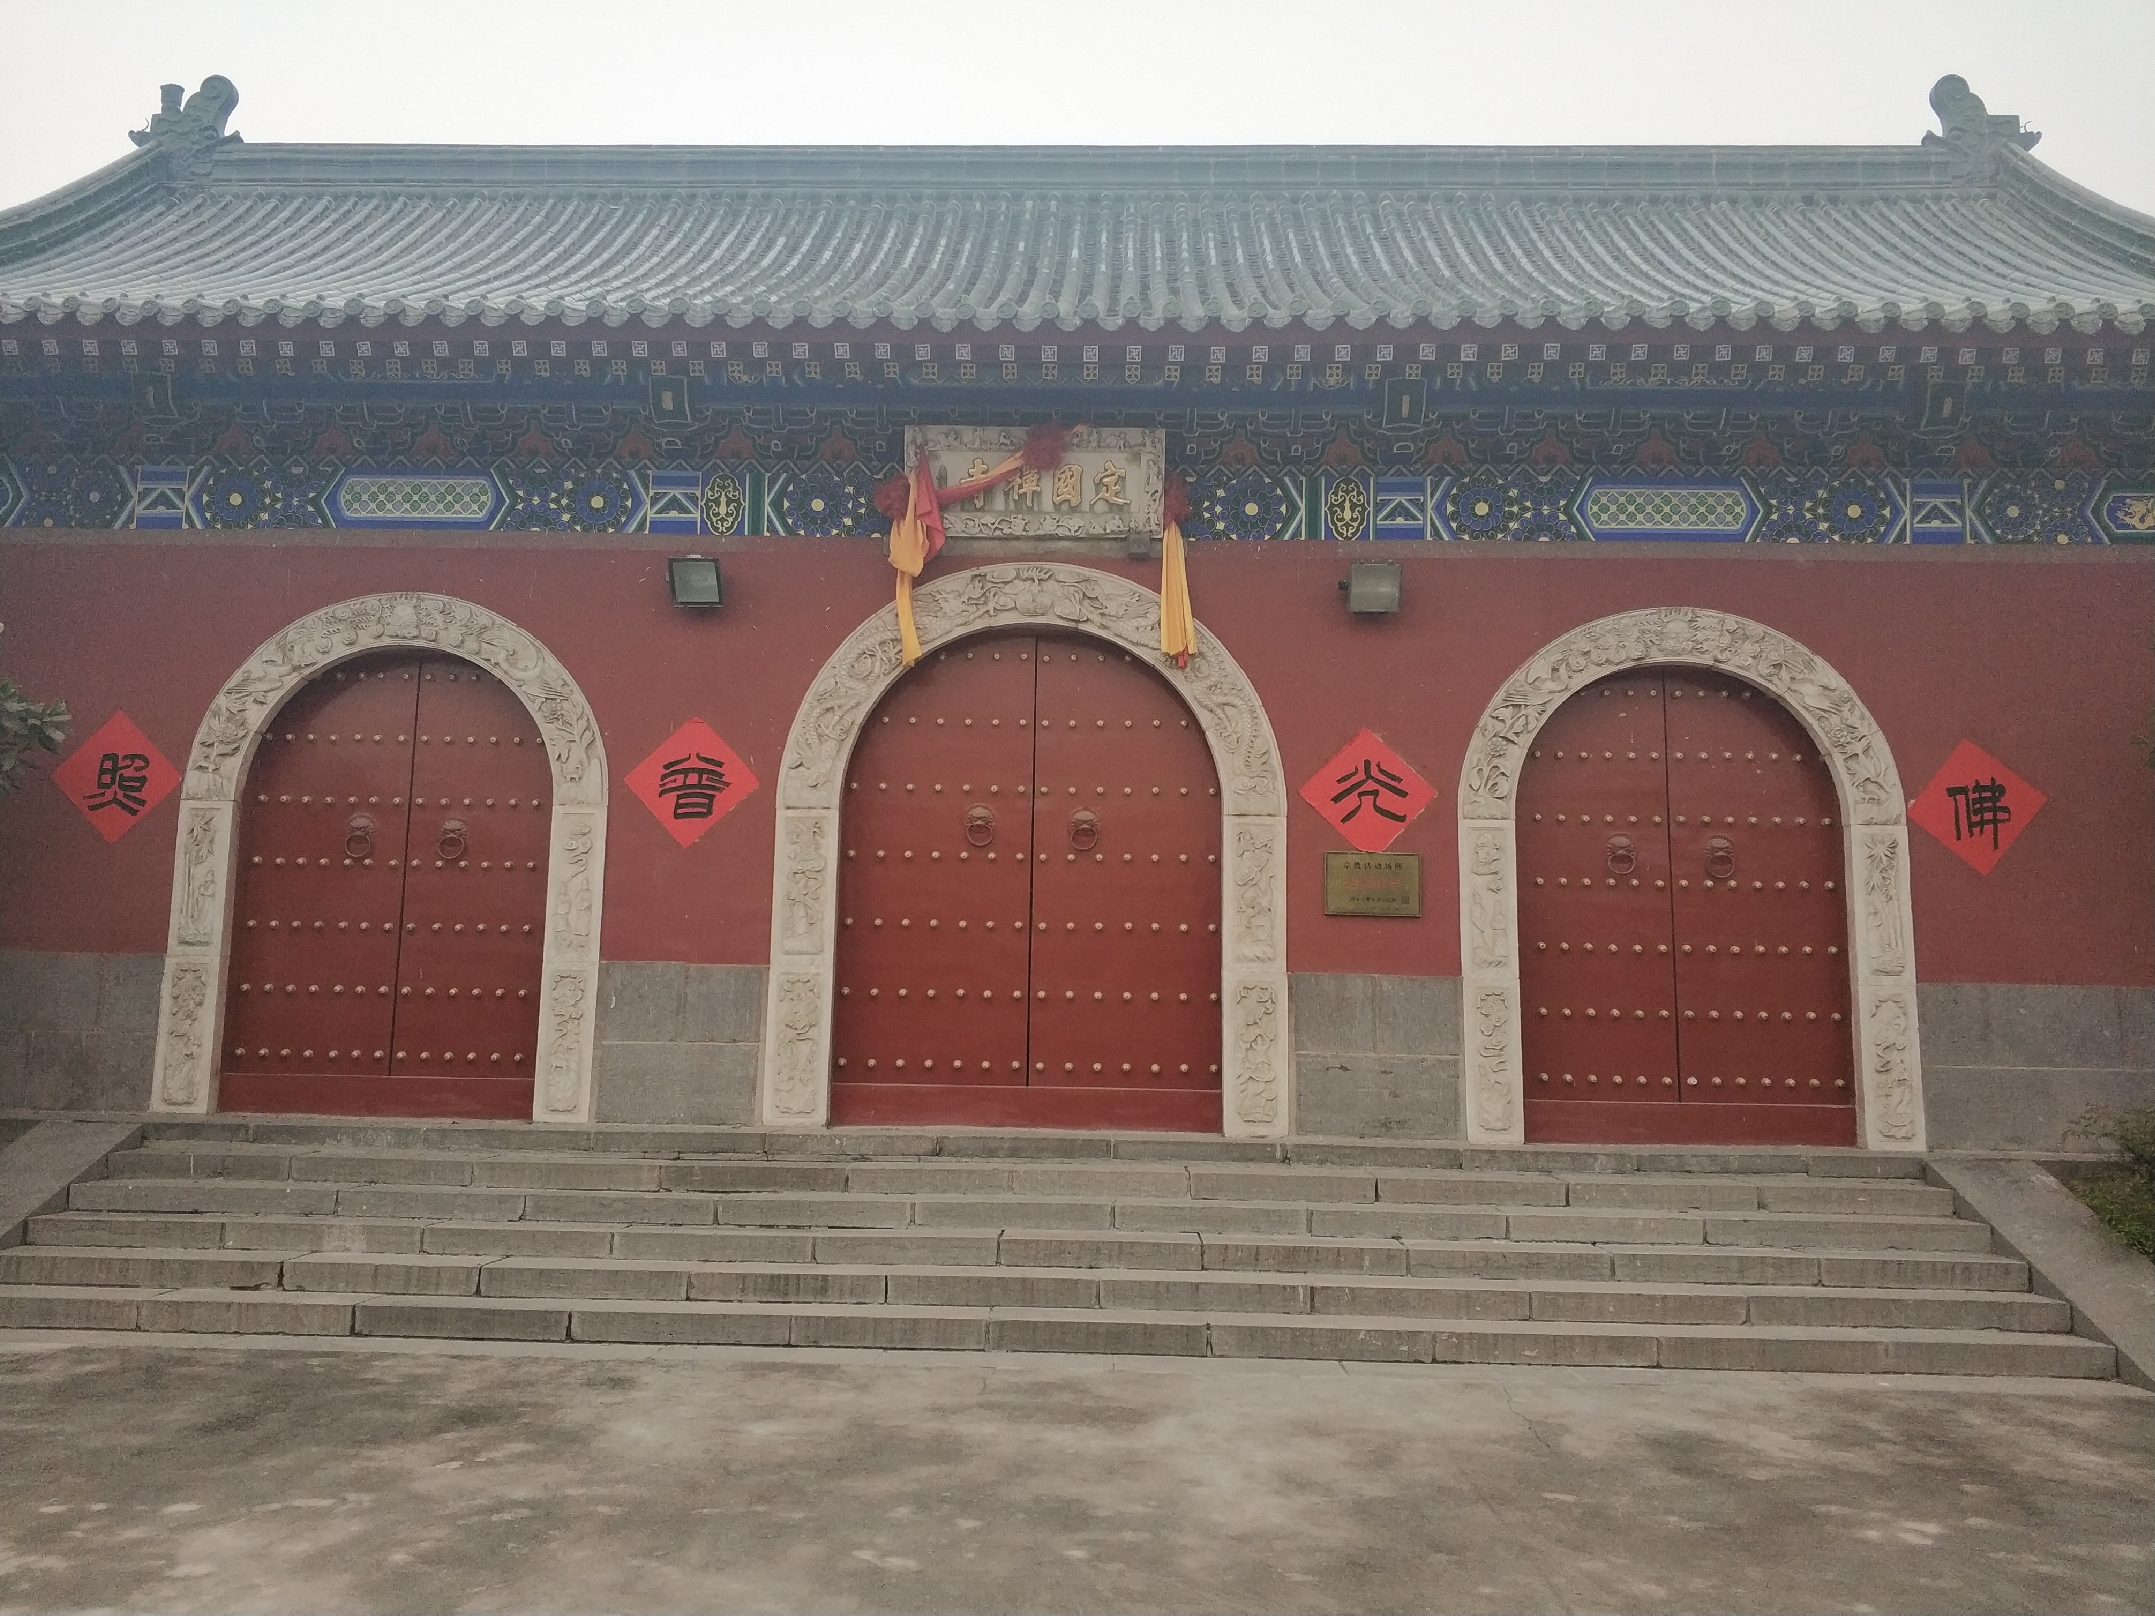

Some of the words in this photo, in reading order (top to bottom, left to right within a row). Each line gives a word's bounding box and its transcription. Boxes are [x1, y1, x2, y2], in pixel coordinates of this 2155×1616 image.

[83, 752, 150, 816] 照
[658, 752, 732, 820] 普
[1330, 759, 1409, 823] 光
[1946, 777, 2011, 850] 佛
